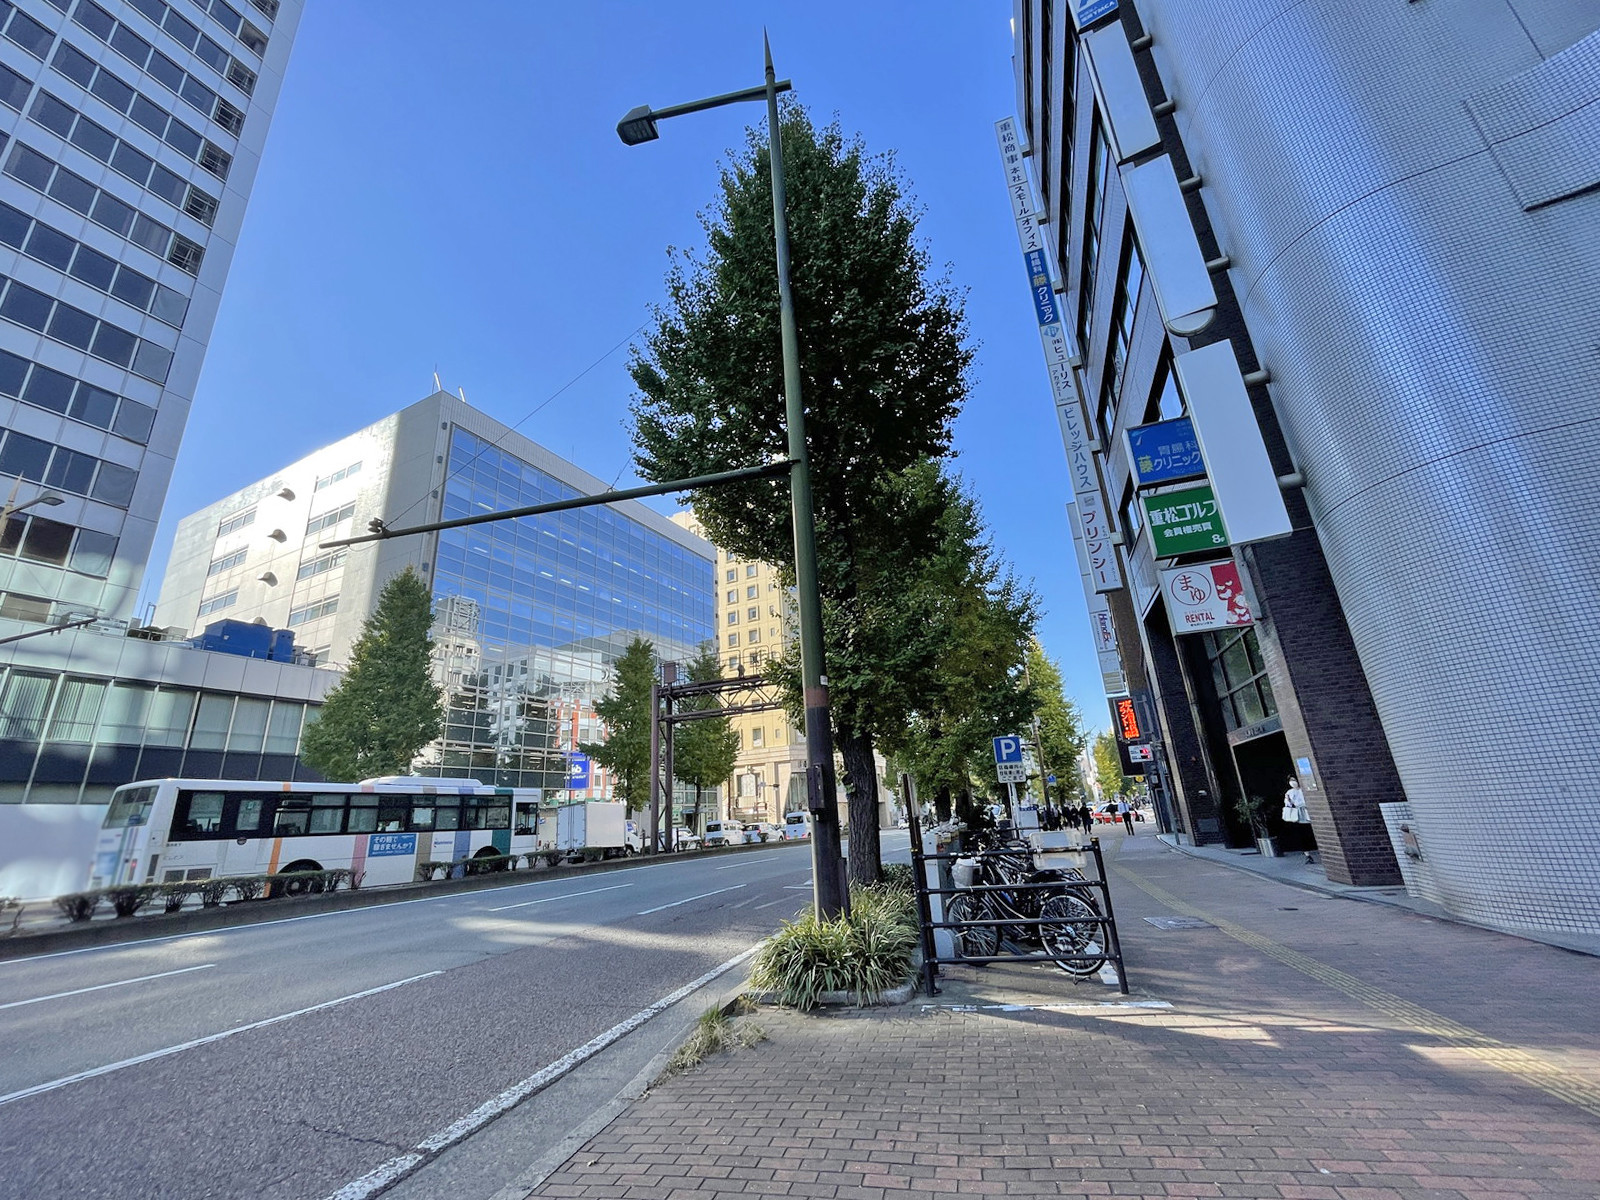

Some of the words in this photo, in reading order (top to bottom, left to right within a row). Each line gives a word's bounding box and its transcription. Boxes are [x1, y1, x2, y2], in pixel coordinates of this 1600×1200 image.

[1064, 407, 1092, 488] ビレッジハウス
[1149, 500, 1218, 527] 重松ゴルフ
[1083, 510, 1106, 584] プリンシー
[1185, 611, 1216, 624] RENTAL
[1000, 739, 1016, 760] P
